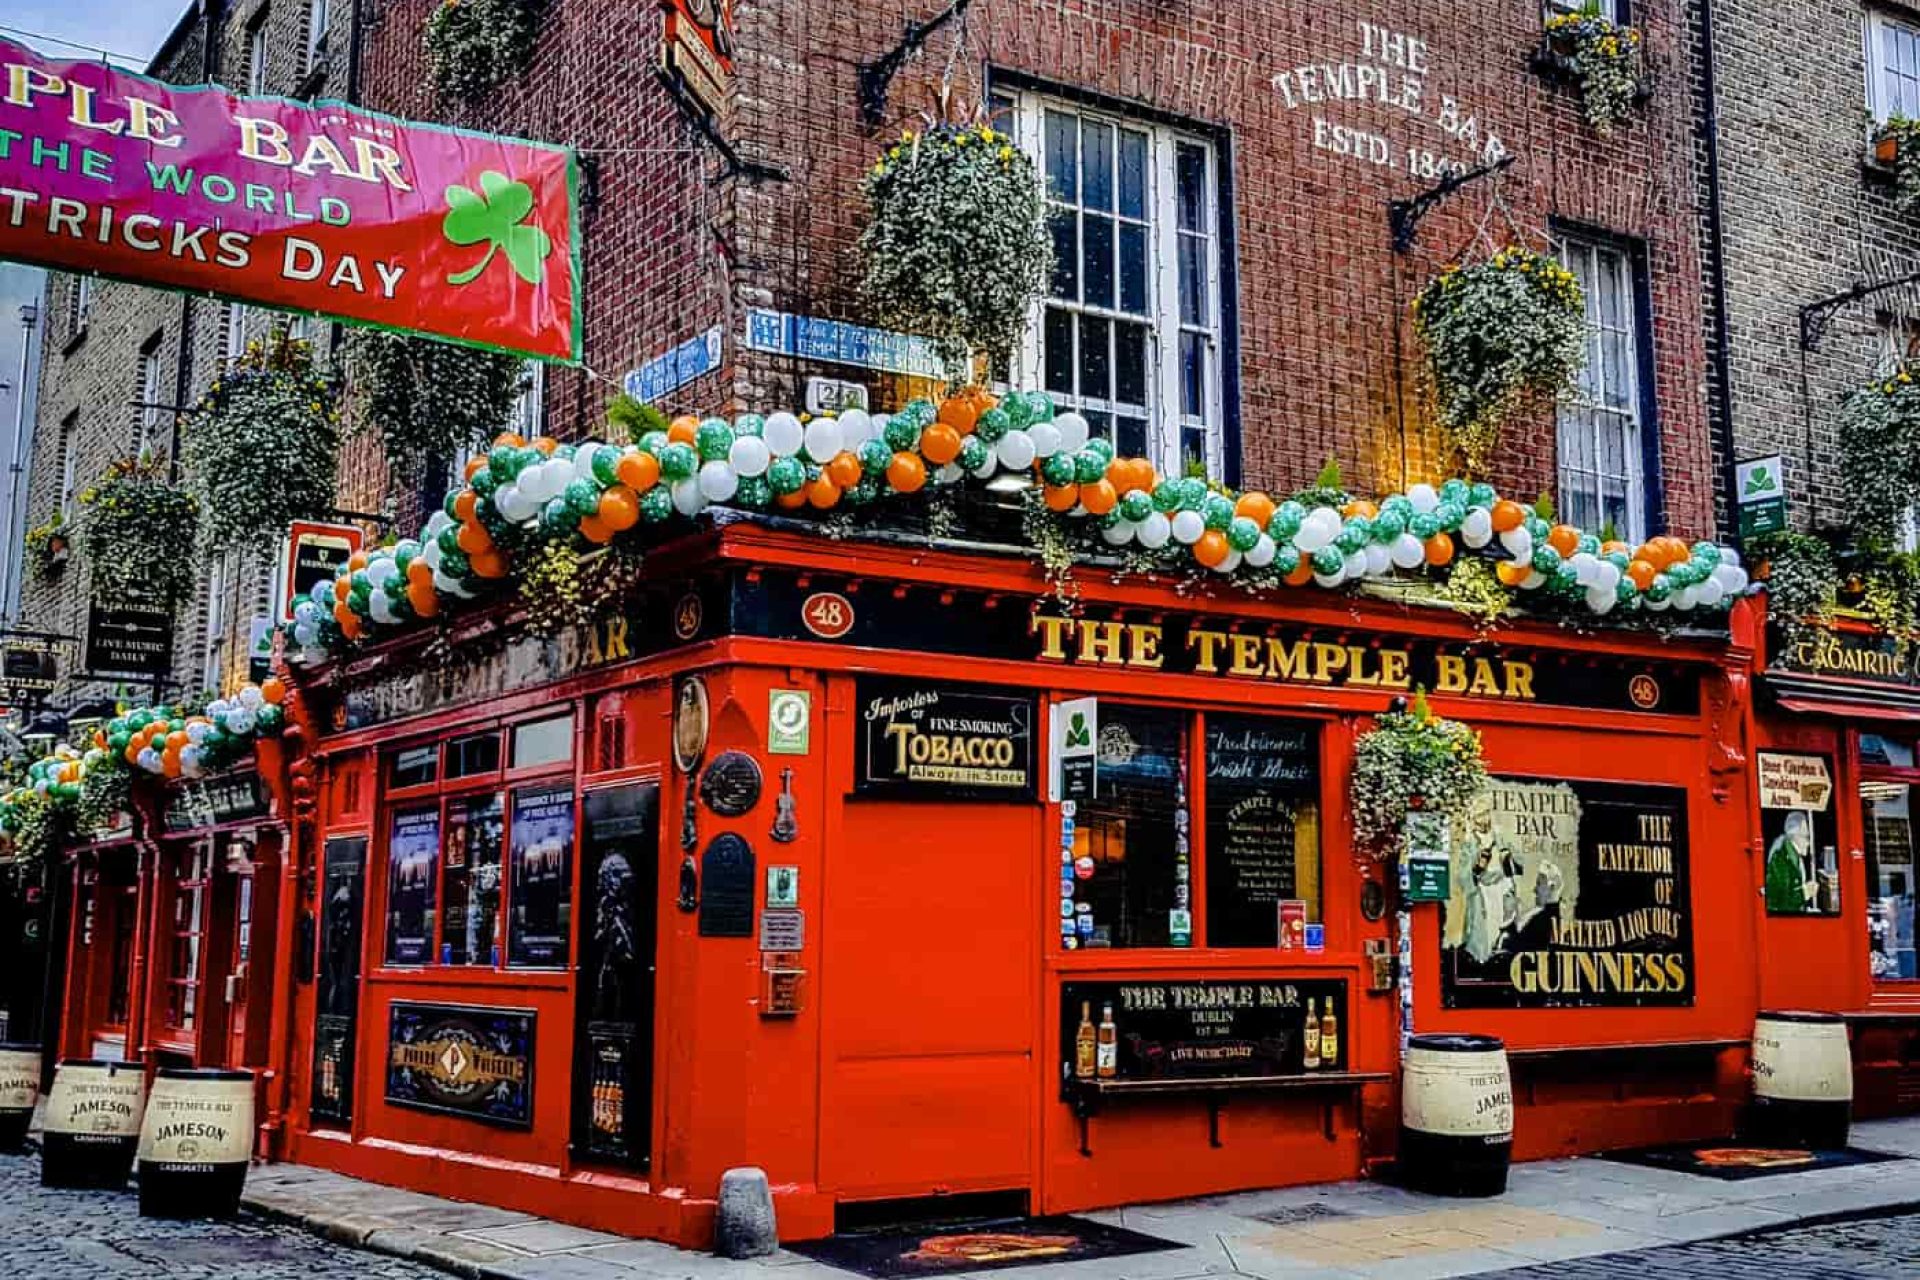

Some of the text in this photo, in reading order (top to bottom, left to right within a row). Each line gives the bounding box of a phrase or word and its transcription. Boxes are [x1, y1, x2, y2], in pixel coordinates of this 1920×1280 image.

[1359, 21, 1427, 75] THE
[1271, 63, 1424, 115] TEMPLE
[233, 116, 412, 192] BAR
[145, 160, 352, 227] WORLD
[283, 237, 406, 299] DAY
[811, 598, 843, 627] 48
[1031, 611, 1536, 699] THE TEMPLE BAR
[864, 690, 940, 722] Importers
[1632, 683, 1654, 703] 48
[930, 717, 1013, 735] FINE SMOKING
[884, 722, 1014, 774] TOBACCO
[1490, 788, 1576, 816] TEMPLE
[1516, 815, 1558, 840] BAR
[1638, 814, 1673, 842] THE
[1598, 843, 1673, 873] EMPEROR
[1654, 877, 1674, 905] OF
[1549, 907, 1682, 949] MALTED LIQUORS
[1509, 951, 1687, 994] GUINNESS
[1120, 984, 1300, 1011] THE TEMPLE BAR
[1191, 1010, 1234, 1024] DUBLIN
[71, 1099, 132, 1117] JAMESON
[155, 1122, 227, 1142] JAMESON
